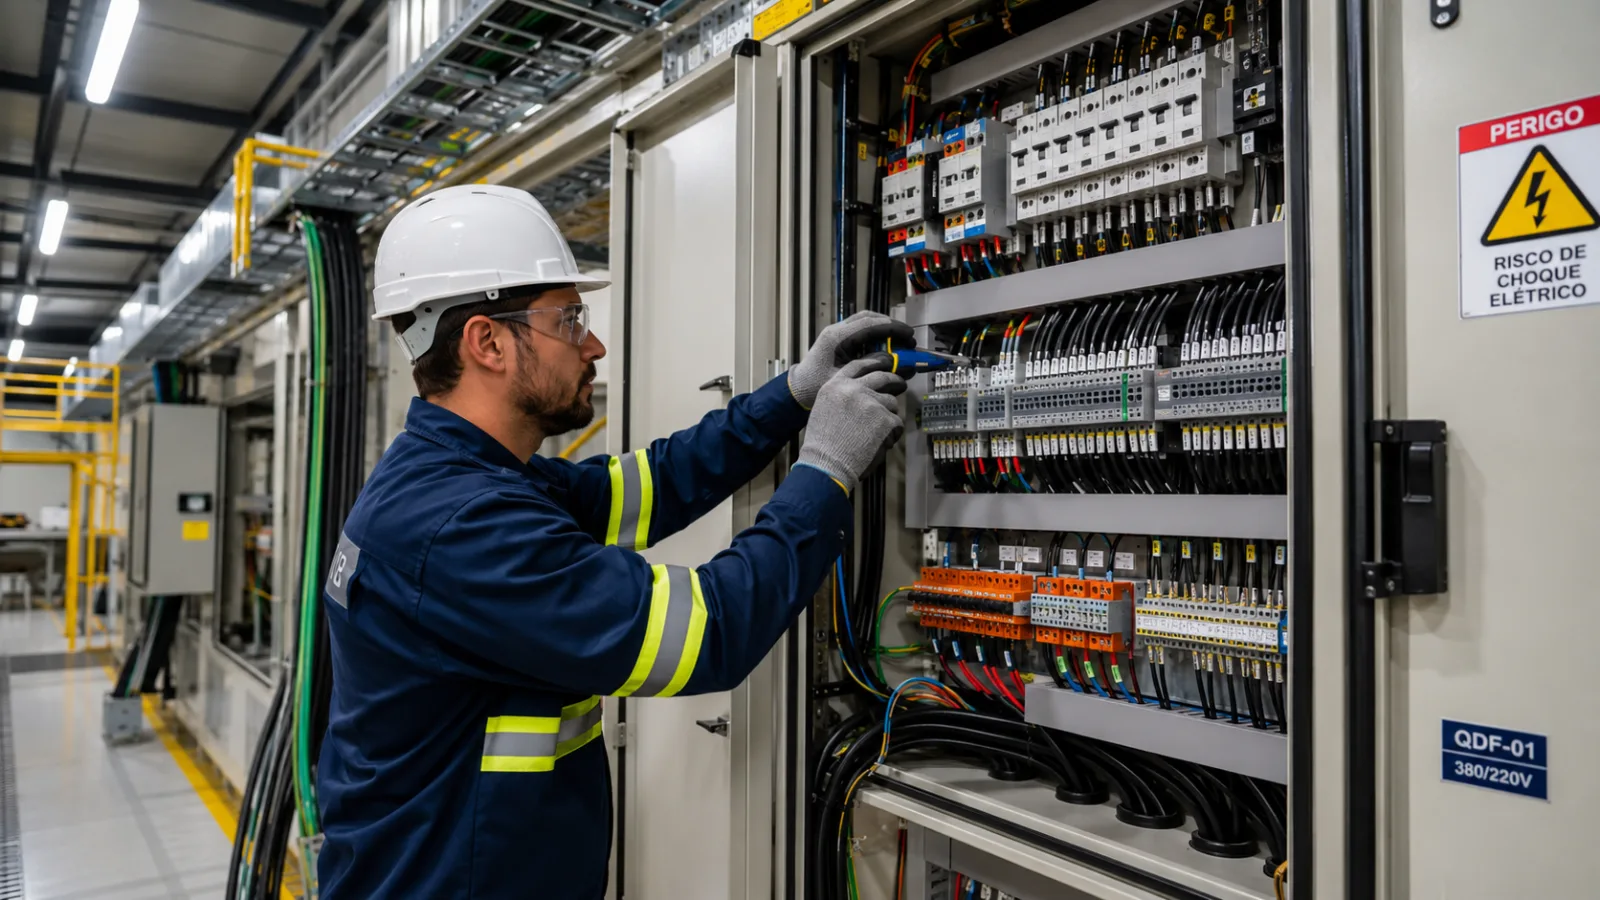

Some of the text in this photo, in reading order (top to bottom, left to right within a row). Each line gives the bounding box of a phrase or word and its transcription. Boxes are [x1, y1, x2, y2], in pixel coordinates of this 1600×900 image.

[1490, 105, 1584, 143] PERIGO
[1494, 244, 1586, 271] RISCO DE
[1497, 264, 1580, 288] CHOQUE
[1490, 283, 1586, 307] ELÉTRICO
[1454, 729, 1534, 760] QDF-01
[1454, 760, 1532, 788] 380/220V
